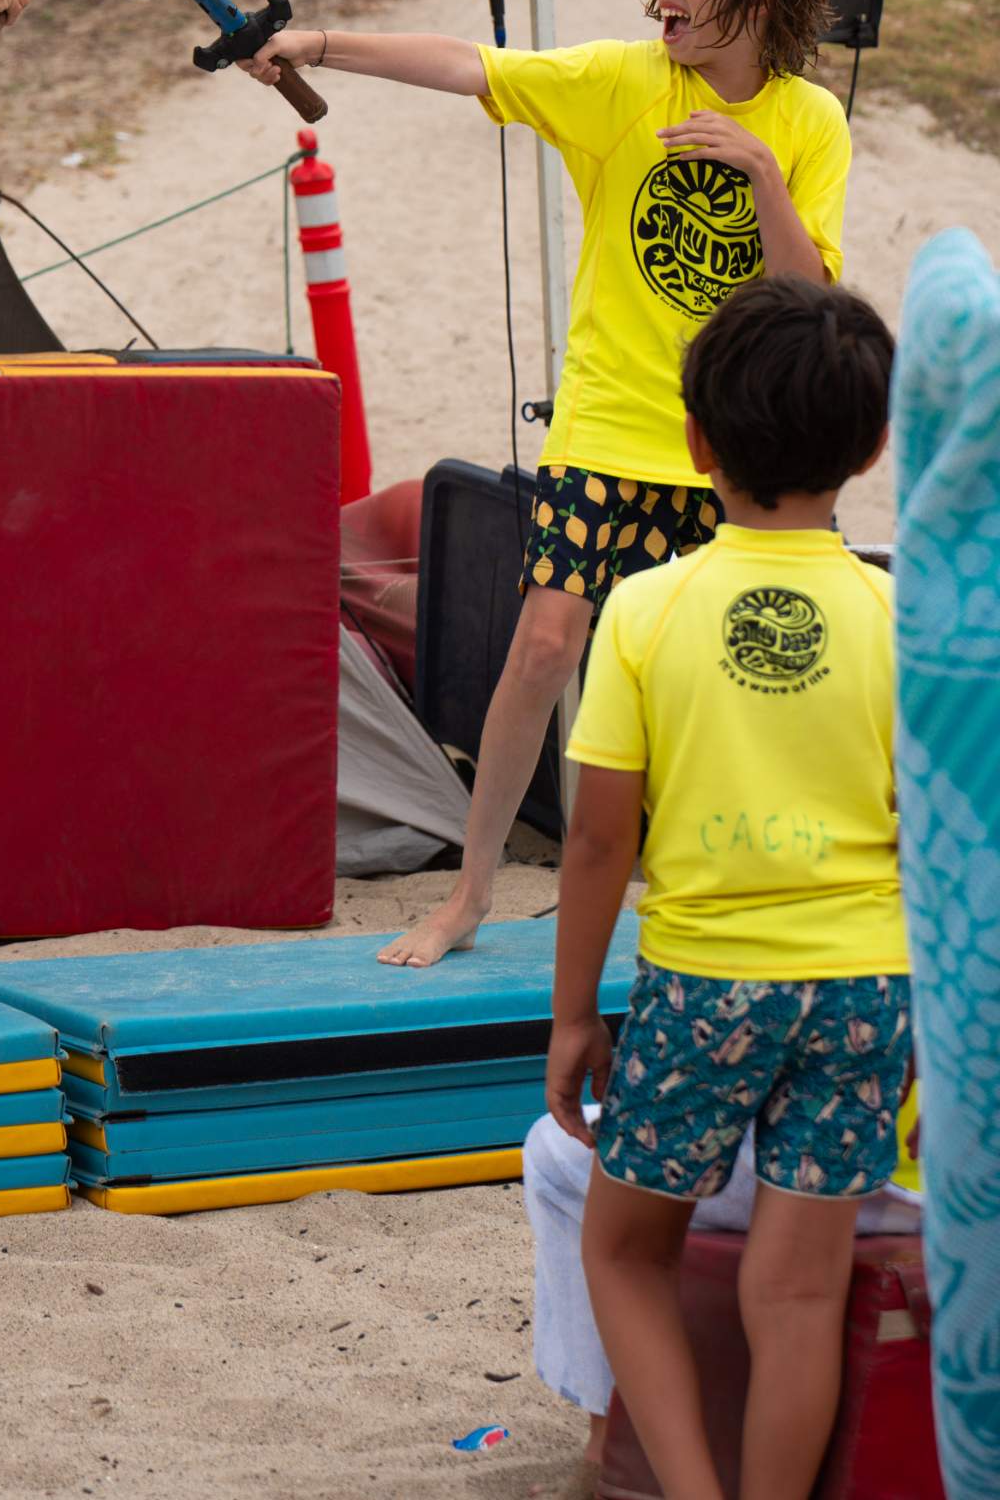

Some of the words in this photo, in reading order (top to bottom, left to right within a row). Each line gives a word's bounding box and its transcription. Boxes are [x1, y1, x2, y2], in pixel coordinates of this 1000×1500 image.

[749, 681, 789, 695] wave
[791, 680, 807, 693] of
[808, 666, 831, 686] life
